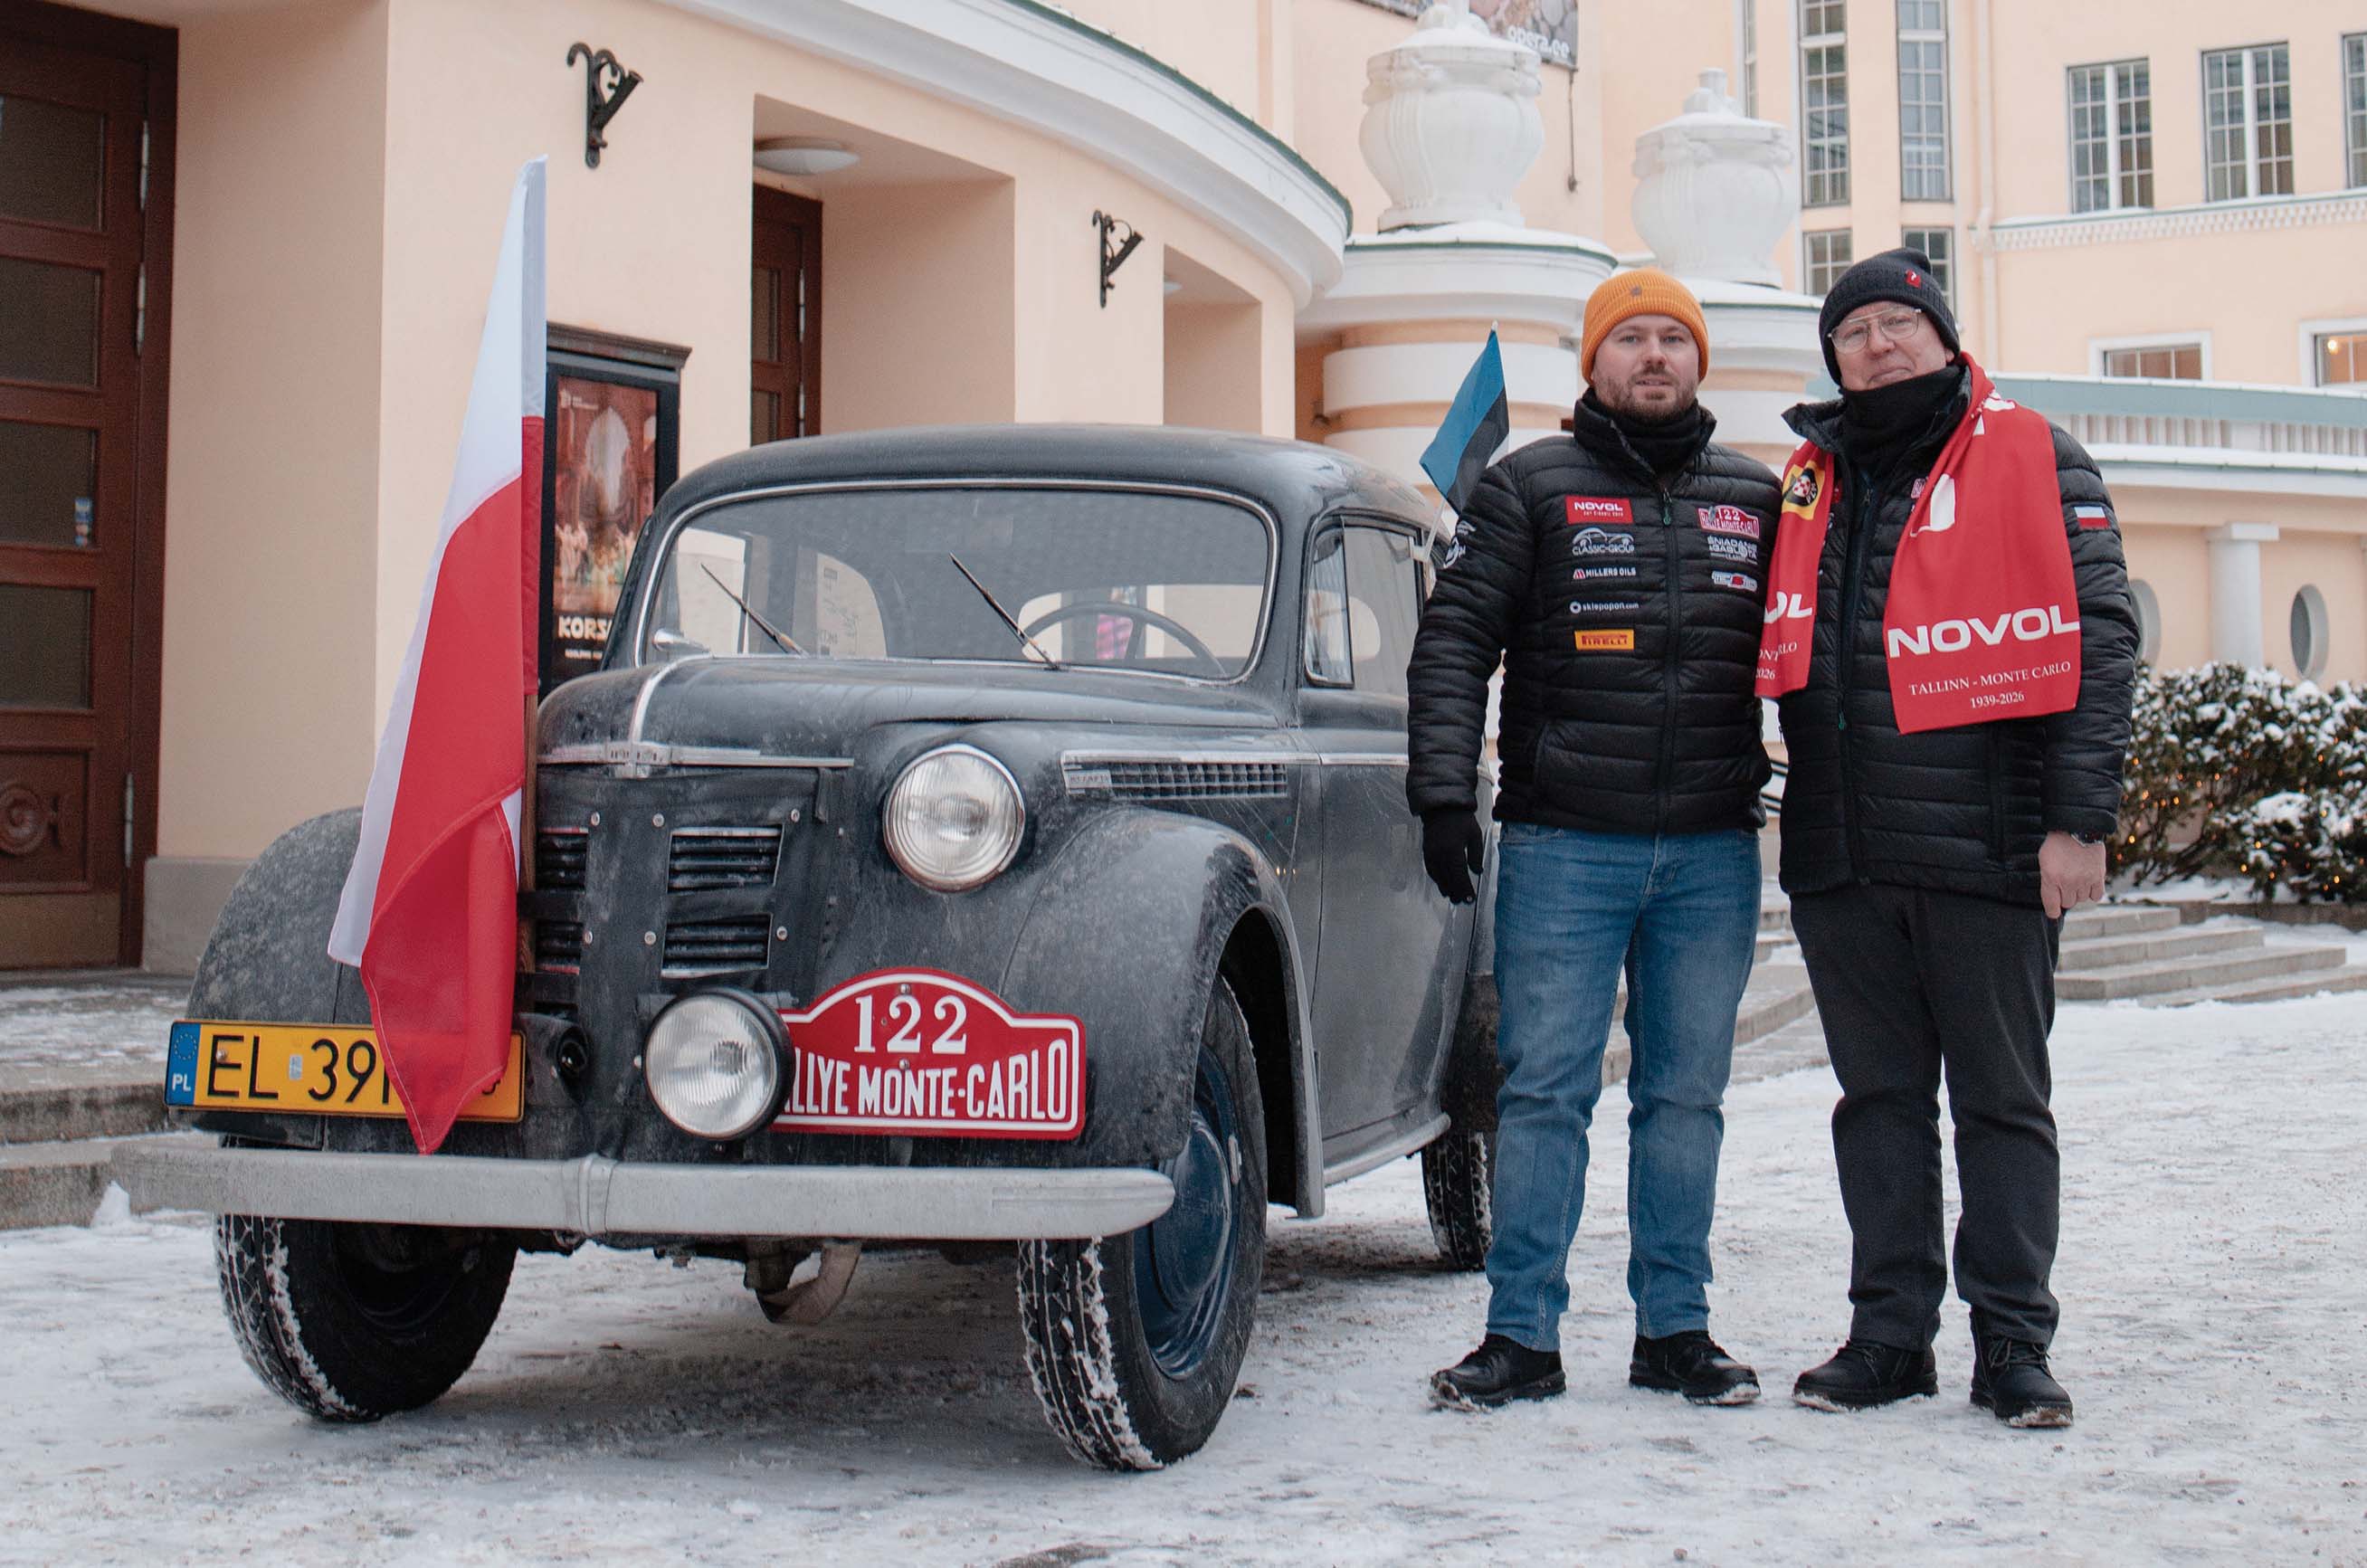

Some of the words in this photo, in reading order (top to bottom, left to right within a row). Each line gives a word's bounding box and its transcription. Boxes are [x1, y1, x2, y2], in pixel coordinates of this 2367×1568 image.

[1574, 501, 1623, 511] NOVOL
[1719, 508, 1741, 521] 122
[1585, 567, 1618, 577] MILLERS
[1619, 566, 1637, 576] OILS
[1887, 604, 2080, 659] NOVOL
[1908, 678, 1970, 696] TALLINN
[1981, 670, 2030, 687] MONTE
[2031, 660, 2071, 679] CARLO
[1970, 691, 2025, 708] 1939-2026
[854, 995, 967, 1055] 122
[207, 1035, 279, 1100] EL
[784, 1047, 851, 1115] LLYE
[858, 1039, 1068, 1121] MONTE-CARLO
[171, 1073, 192, 1093] PL
